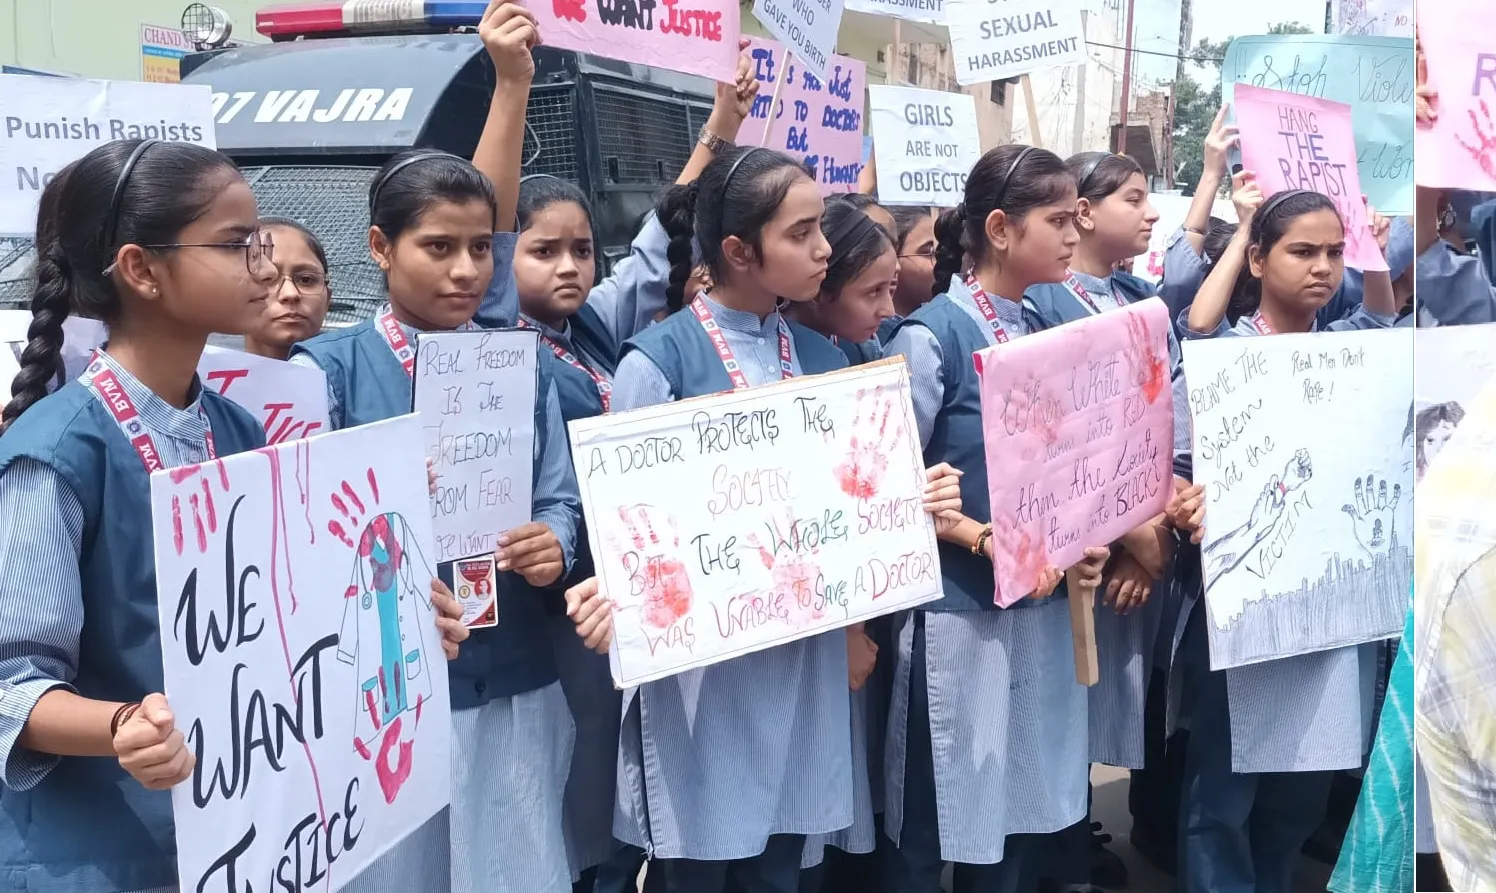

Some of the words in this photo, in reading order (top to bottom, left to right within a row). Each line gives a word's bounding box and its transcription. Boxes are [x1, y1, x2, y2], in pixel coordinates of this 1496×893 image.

[660, 0, 722, 41] JUSTICE
[792, 0, 815, 26] WHO
[980, 9, 1058, 40] SEXUAL
[144, 27, 181, 47] CHAND
[763, 0, 787, 29] GAVE
[787, 20, 805, 47] YOU
[804, 39, 827, 71] BIRTH
[968, 36, 1078, 72] HARASSMENT
[253, 87, 414, 123] VAJRA
[904, 103, 954, 127] GIRLS
[1278, 105, 1319, 134] HANG
[6, 116, 100, 140] Punish
[109, 119, 203, 142] Rapists
[1278, 131, 1329, 162] THE
[906, 140, 931, 157] ARE
[935, 144, 958, 158] NOT
[900, 171, 967, 193] OBJECTS
[1278, 157, 1346, 197] RAPIST
[974, 294, 992, 316] BVM
[384, 318, 403, 343] BVM
[712, 332, 730, 356] BVM
[422, 341, 464, 376] REAL
[474, 333, 528, 371] FREEDOM
[1291, 350, 1313, 377] Real
[1318, 352, 1336, 369] Men
[100, 376, 130, 414] BVM
[441, 386, 462, 415] IS
[478, 381, 504, 413] THE
[1190, 367, 1236, 416] BLAME
[1234, 347, 1269, 384] THE
[588, 447, 607, 478] A
[615, 436, 685, 474] DOCTOR
[691, 407, 780, 455] PROTECTS
[793, 396, 836, 439] THE
[1200, 398, 1263, 469] System
[1068, 456, 1106, 500] the
[1212, 461, 1243, 503] Not
[1247, 435, 1275, 468] the
[478, 468, 515, 510] FEAR
[1047, 516, 1081, 554] turns
[1087, 492, 1110, 532] into
[1244, 489, 1314, 580] VICTIM
[622, 550, 667, 597] BUT
[690, 533, 741, 576] THE
[764, 508, 848, 556] WHOLE
[857, 496, 920, 535] SOCIETY
[174, 494, 265, 667] WE
[638, 616, 696, 657] WAS
[708, 592, 790, 639] UNABLE
[814, 572, 848, 619] SAVE
[854, 565, 867, 596] A
[868, 551, 935, 601] DOCTOR
[187, 633, 339, 809] WANT
